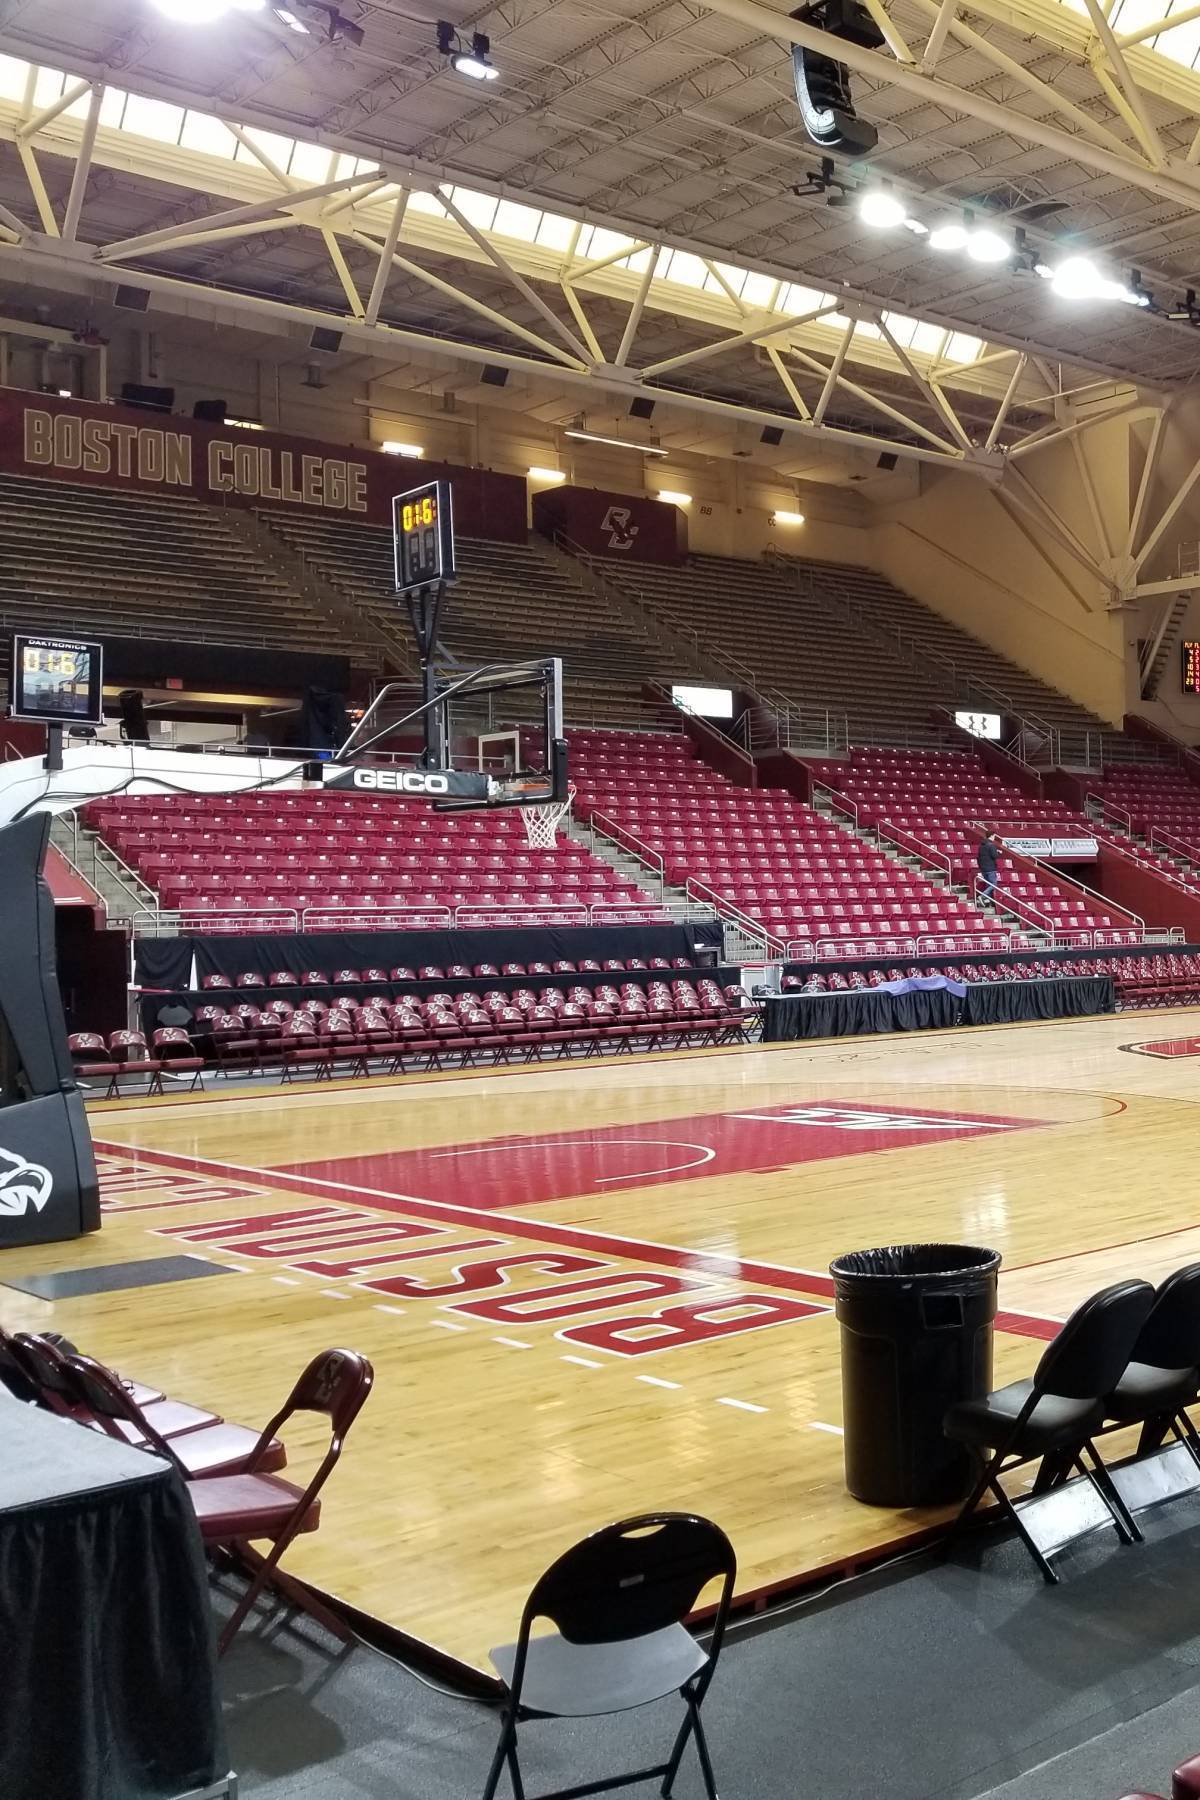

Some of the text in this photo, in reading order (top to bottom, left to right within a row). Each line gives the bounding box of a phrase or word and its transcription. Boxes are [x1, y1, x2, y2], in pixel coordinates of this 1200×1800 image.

[24, 408, 368, 512] BOSTON COLLEGE
[353, 769, 449, 793] GEICO
[149, 1206, 836, 1357] BOSTON
